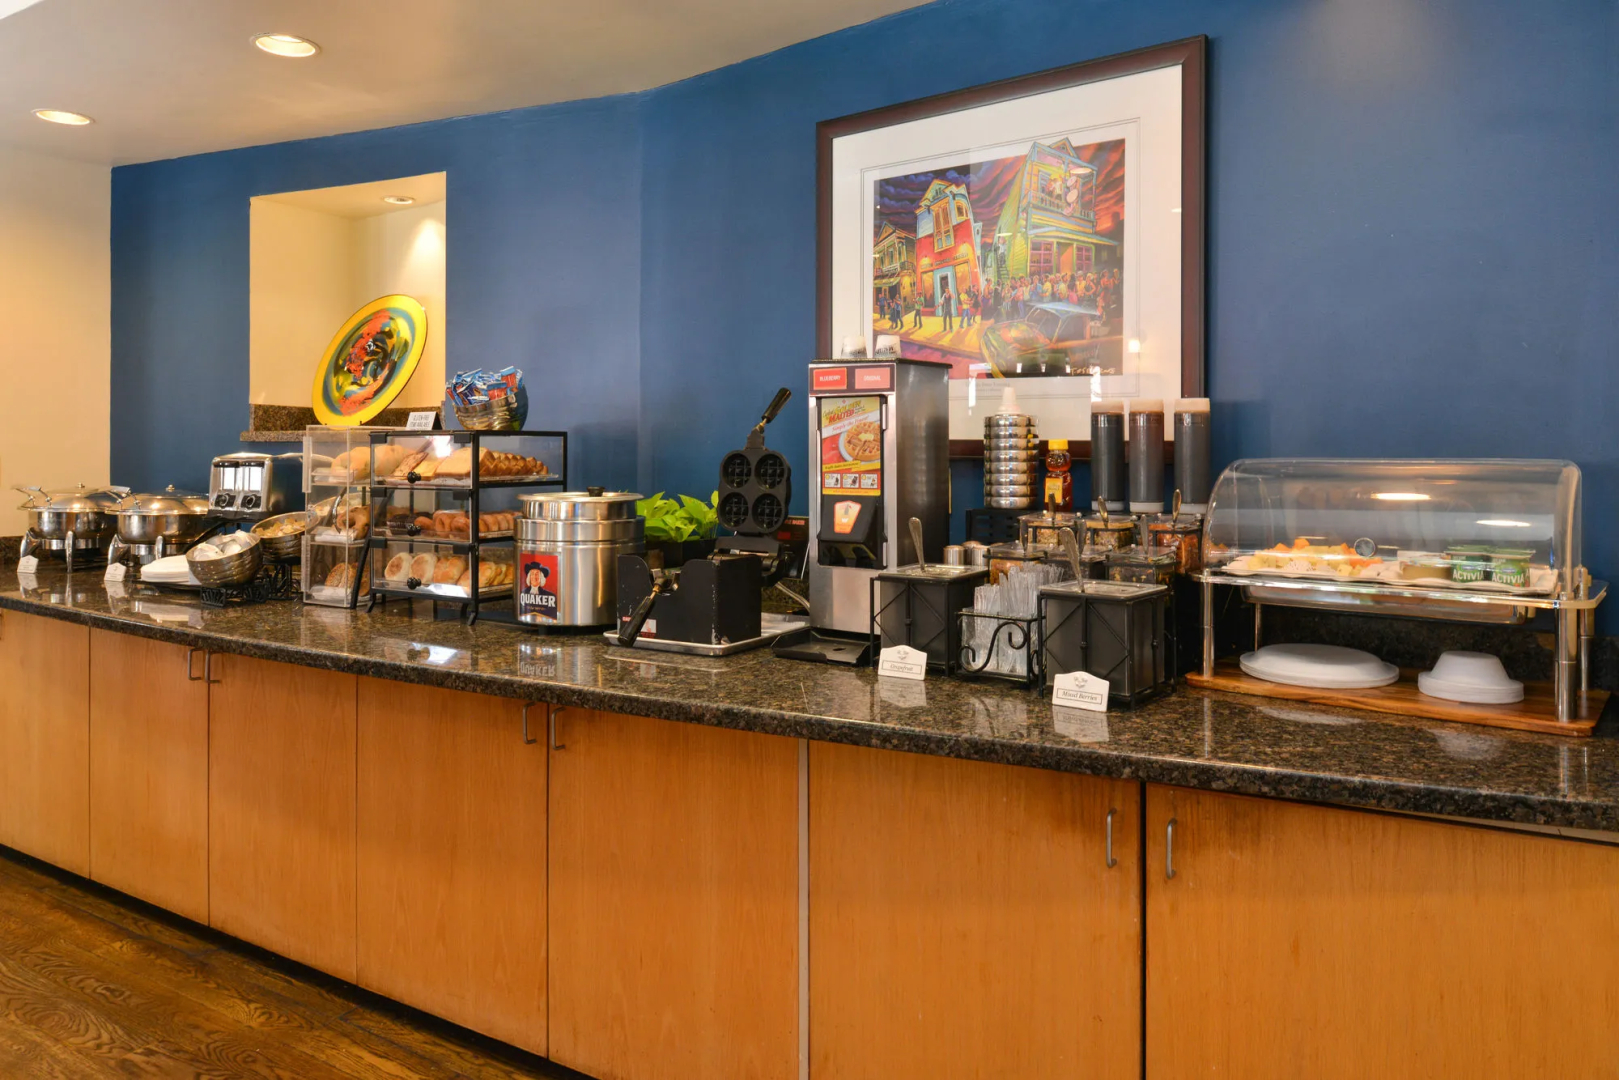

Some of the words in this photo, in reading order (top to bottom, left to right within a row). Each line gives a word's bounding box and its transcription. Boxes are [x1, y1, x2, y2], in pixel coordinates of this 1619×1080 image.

[828, 408, 855, 423] MALTED
[1452, 569, 1485, 580] ACTIVIA
[1491, 572, 1525, 584] ACTIVIA
[520, 593, 556, 608] QUAKER
[890, 663, 914, 673] Grapefruit
[1061, 690, 1079, 698] Mixed
[1078, 692, 1098, 702] Berries
